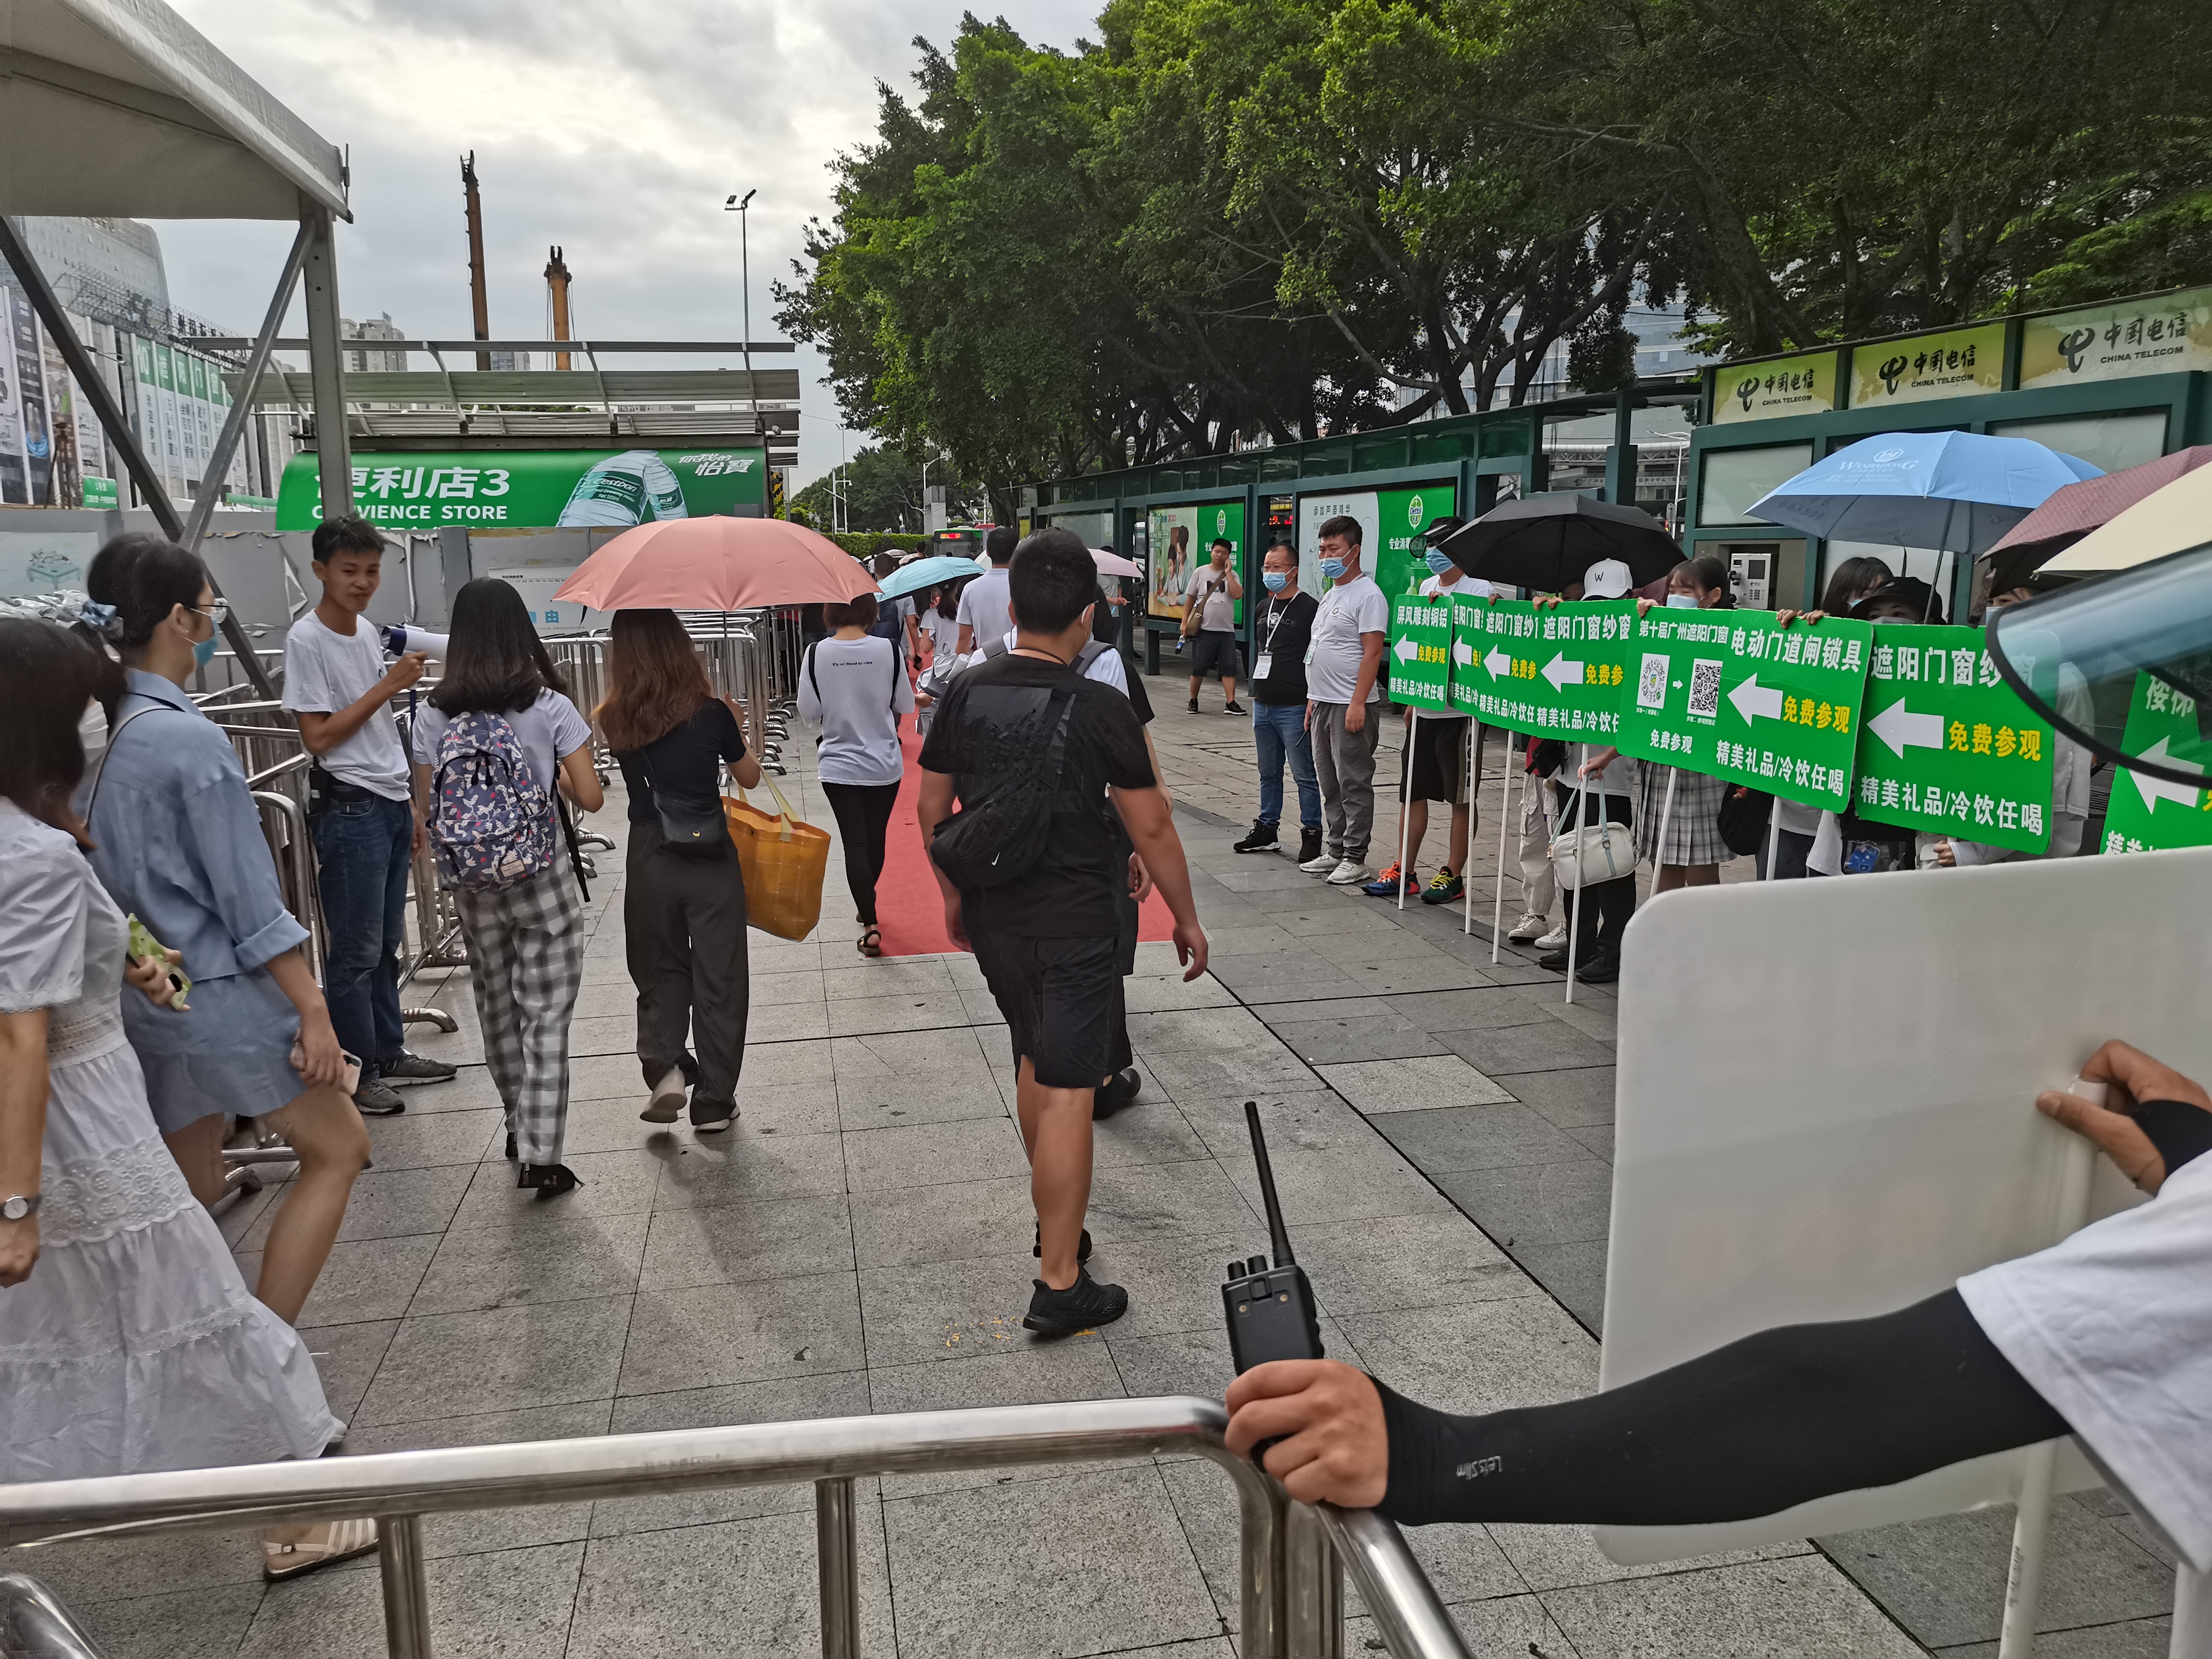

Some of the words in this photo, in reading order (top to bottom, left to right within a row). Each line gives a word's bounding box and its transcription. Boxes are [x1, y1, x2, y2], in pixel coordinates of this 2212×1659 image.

[2104, 312, 2188, 350] 中国电信
[1914, 344, 1976, 375] 中国电信
[2100, 352, 2131, 363] CHINA
[2134, 346, 2183, 359] TELECOM
[1764, 368, 1815, 395] 中国电信
[1911, 379, 1935, 387] CHINA
[1936, 373, 1973, 384] TELECOM
[1783, 395, 1812, 403] TELECOM
[695, 459, 755, 476] 怡寶
[441, 505, 507, 519] STORE
[1595, 572, 1604, 582] W
[1639, 619, 1729, 644] 第十届广州遮阳门窗
[1418, 645, 1445, 664] 免费参观
[1731, 626, 1862, 673] 电动门道闸锁具
[1511, 658, 1536, 680] 免费参
[1586, 663, 1623, 685] 免费参
[1390, 676, 1444, 702] 精美礼品/冷饮任喝
[1783, 695, 1851, 733] 免费参观
[1650, 729, 1693, 754] 免费参观
[1948, 721, 2041, 761] 免费参观
[1716, 739, 1844, 797] 精美礼品/冷饮任喝
[1861, 775, 2043, 836] 精美礼品/冷饮任喝
